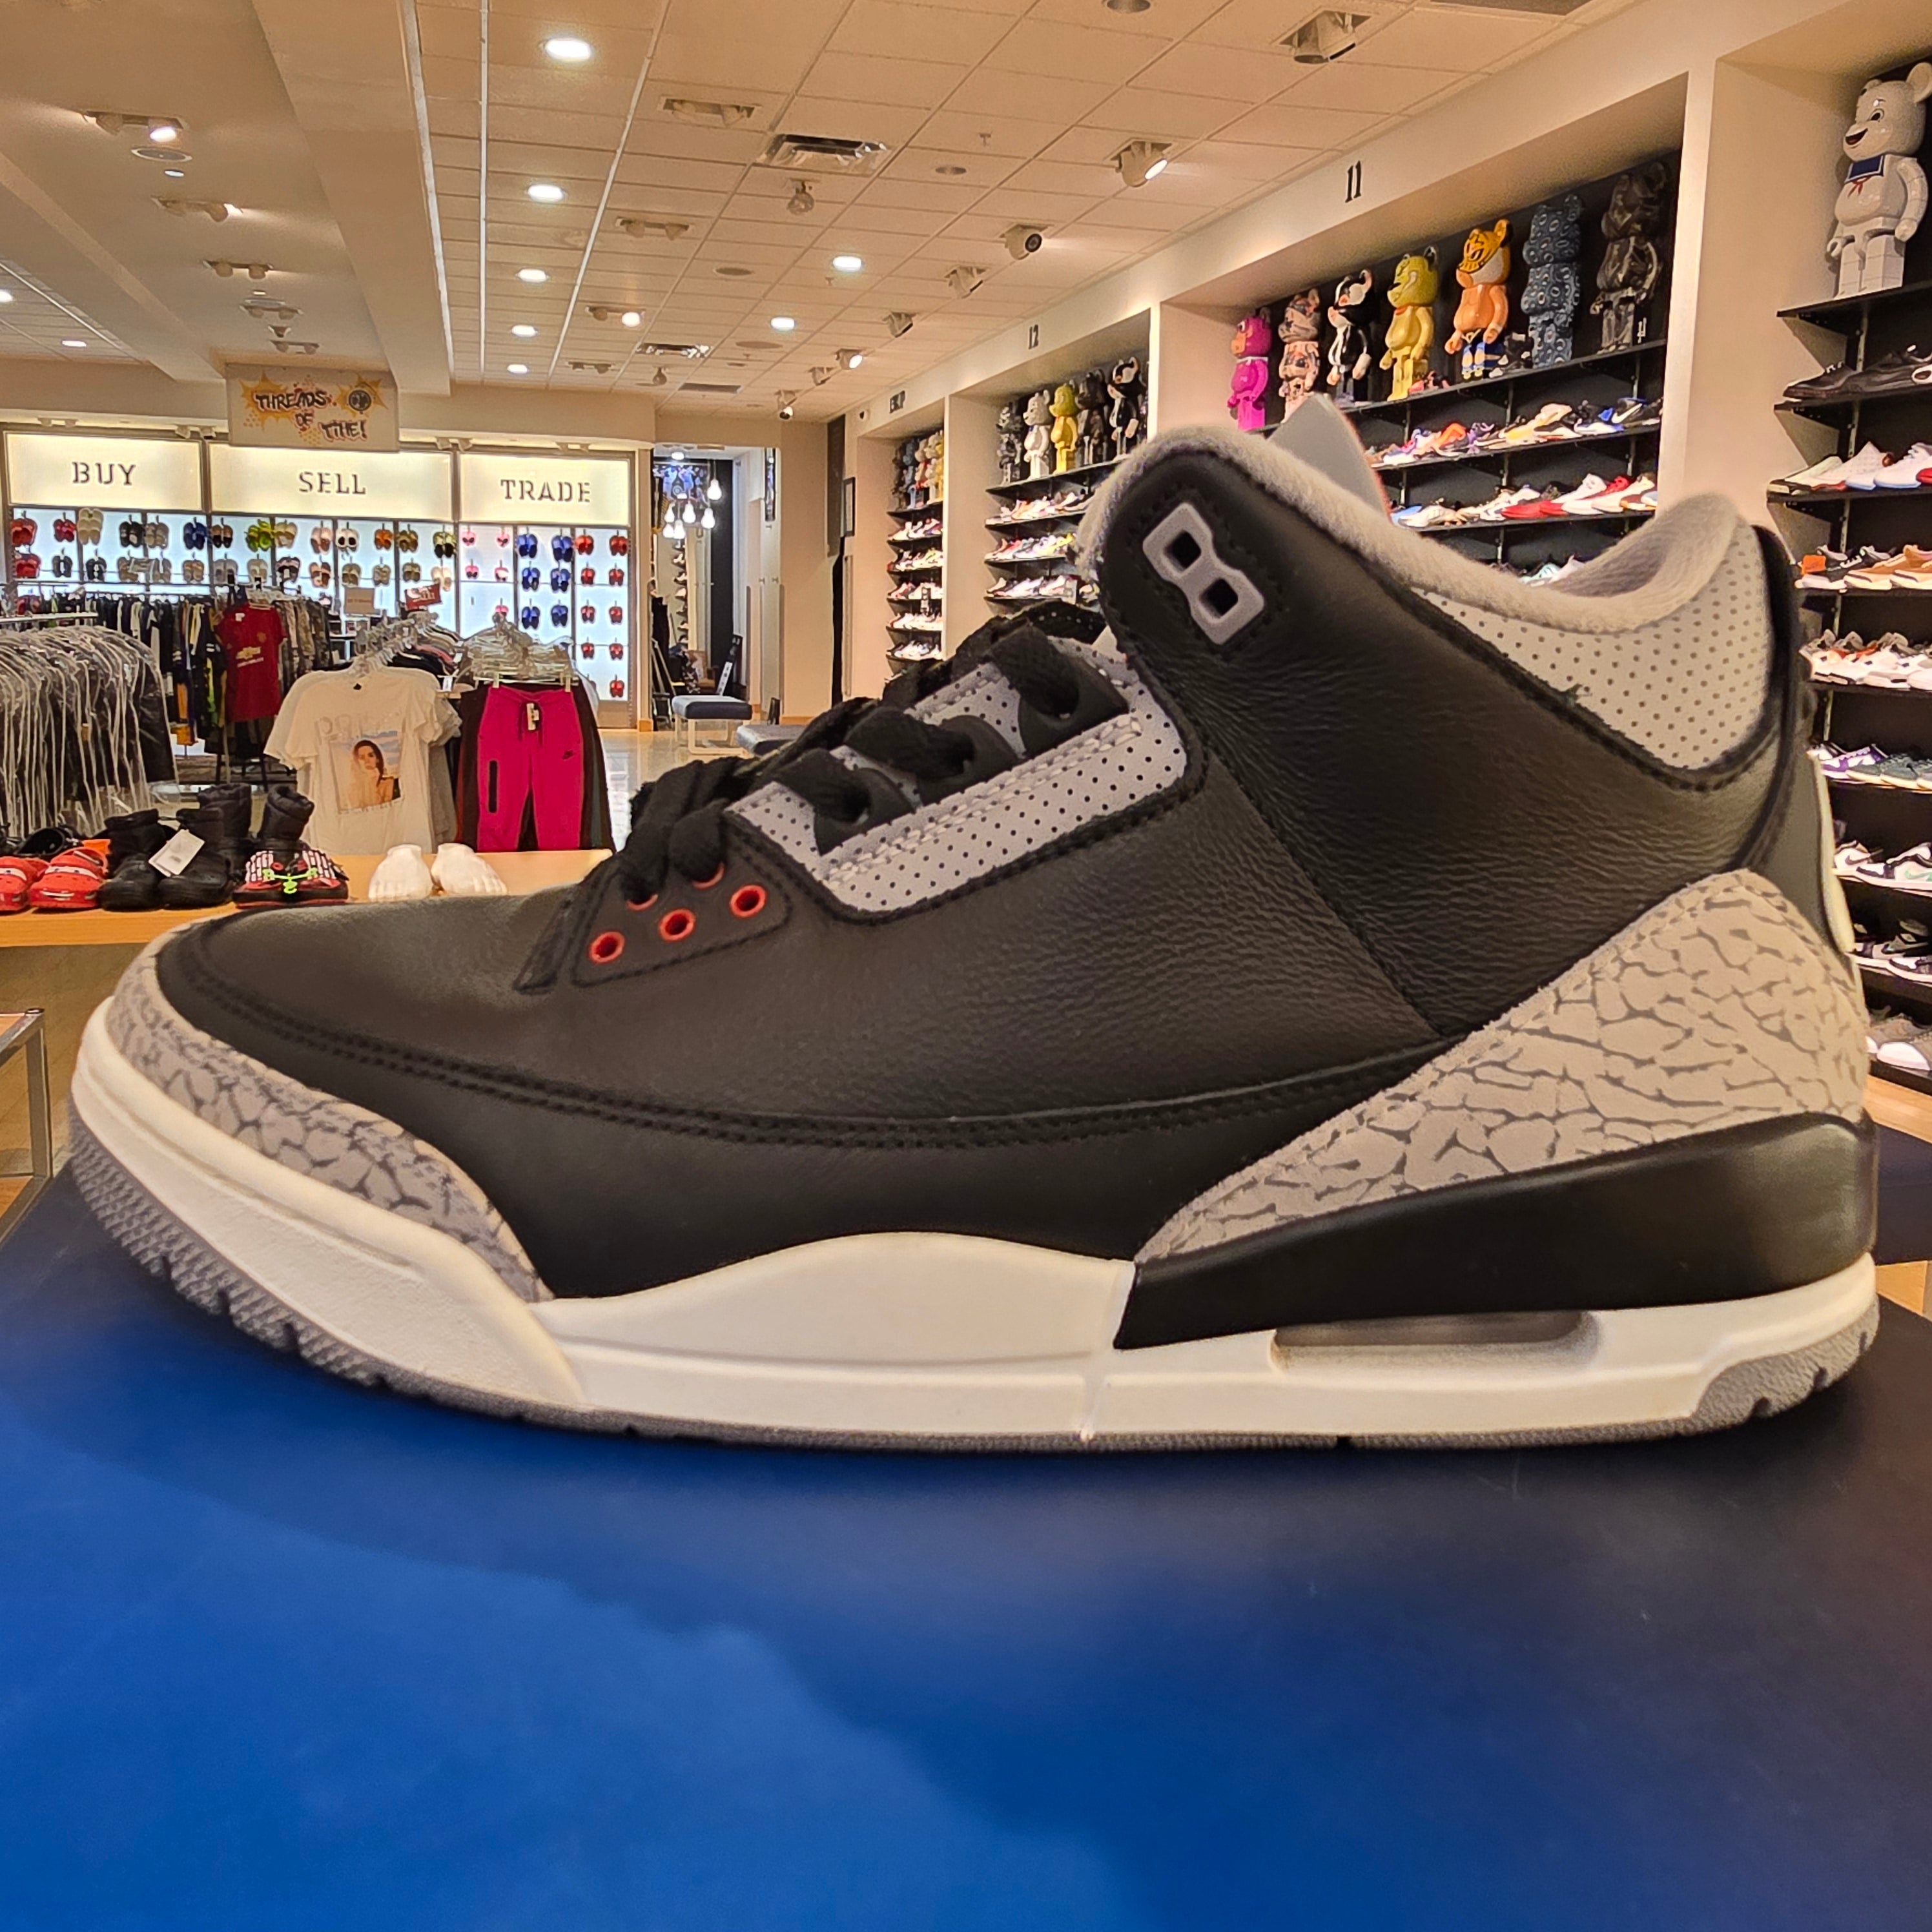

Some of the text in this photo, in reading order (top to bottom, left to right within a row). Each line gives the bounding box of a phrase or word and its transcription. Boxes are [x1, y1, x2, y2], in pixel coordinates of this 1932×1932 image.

[1028, 324, 1039, 349] 12
[254, 389, 329, 411] THREADS
[295, 413, 315, 427] OF
[72, 461, 136, 486] BUY
[298, 471, 366, 495] SELL
[500, 479, 591, 502] TRADE
